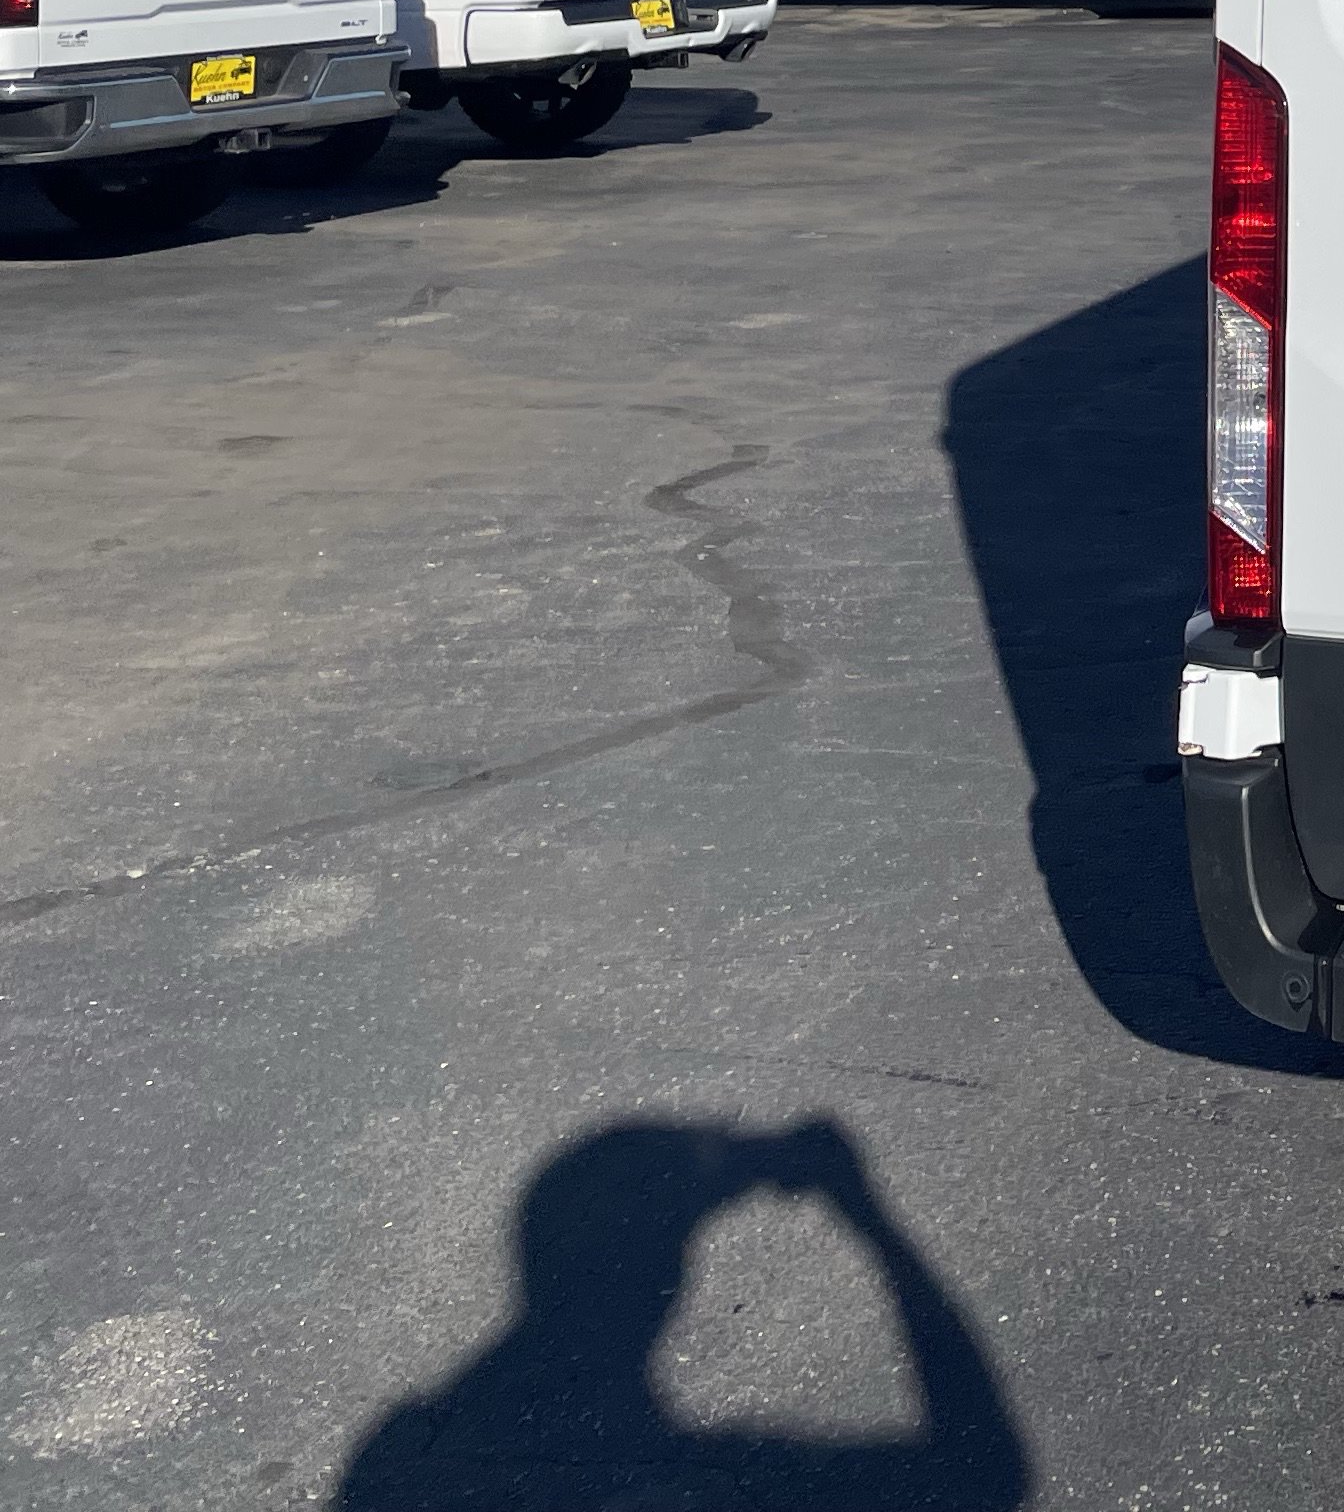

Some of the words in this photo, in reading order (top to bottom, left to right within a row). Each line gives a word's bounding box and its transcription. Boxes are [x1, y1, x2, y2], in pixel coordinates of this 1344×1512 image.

[340, 18, 368, 28] SLT
[193, 64, 227, 87] Kuehn
[206, 91, 240, 104] Kuehn
